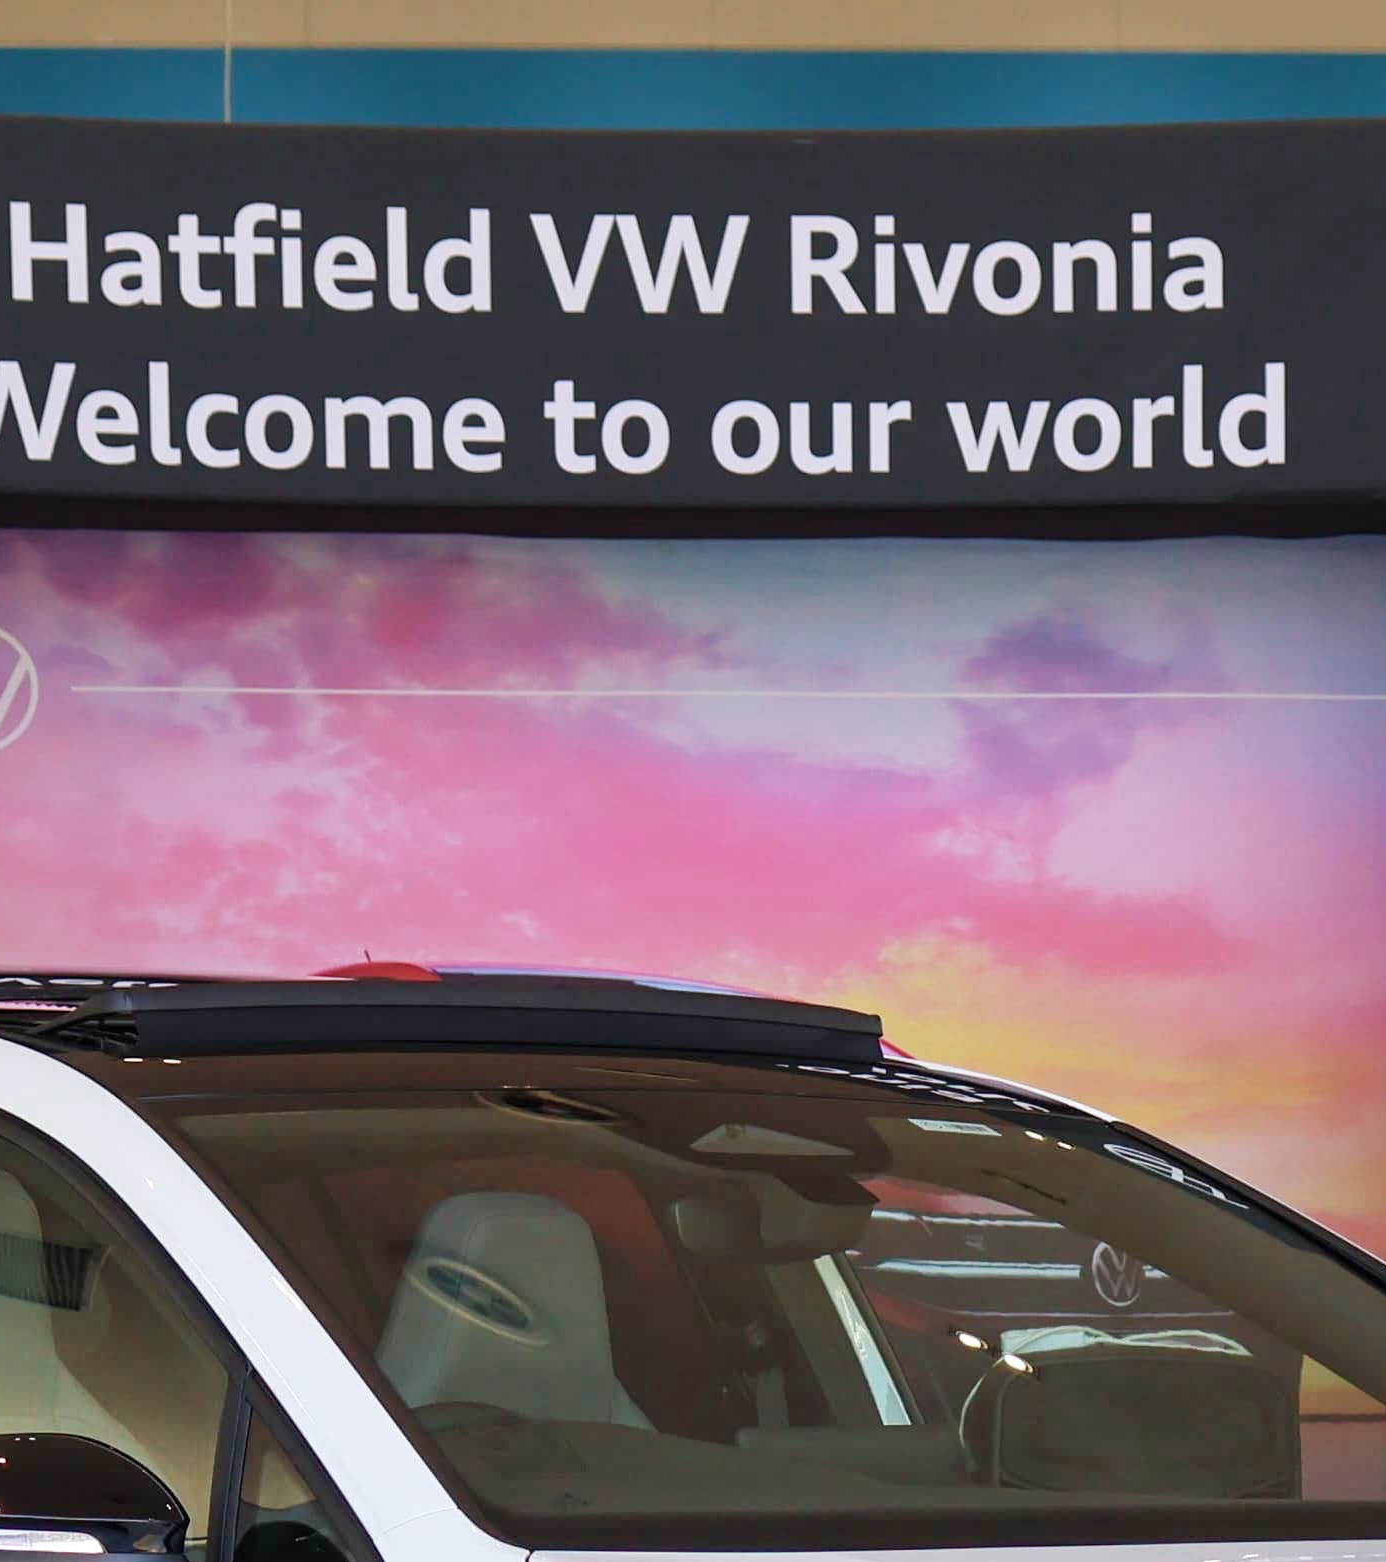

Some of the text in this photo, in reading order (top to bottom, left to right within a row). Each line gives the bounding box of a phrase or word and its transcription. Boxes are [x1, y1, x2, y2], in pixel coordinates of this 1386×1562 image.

[10, 202, 1223, 315] Hatfield VW Rivonia
[544, 381, 669, 473] to
[712, 401, 911, 474] our
[947, 363, 1285, 471] world
